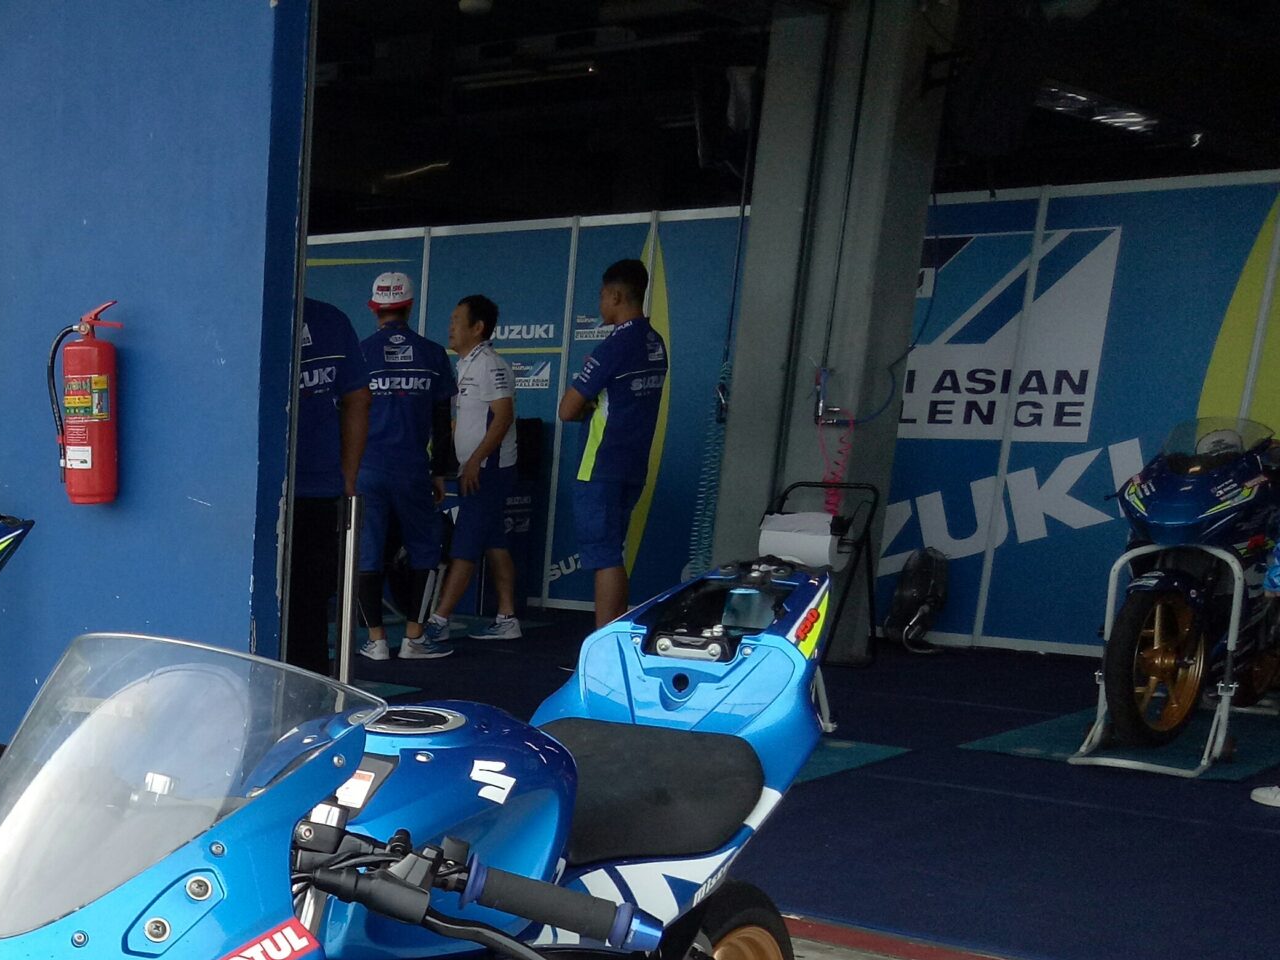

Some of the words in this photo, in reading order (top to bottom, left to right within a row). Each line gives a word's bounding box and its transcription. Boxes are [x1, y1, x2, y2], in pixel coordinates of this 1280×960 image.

[369, 377, 432, 391] SUZUKI
[931, 368, 1090, 395] ASIAN
[899, 400, 1085, 428] LENGE
[876, 437, 1145, 578] ZUKI
